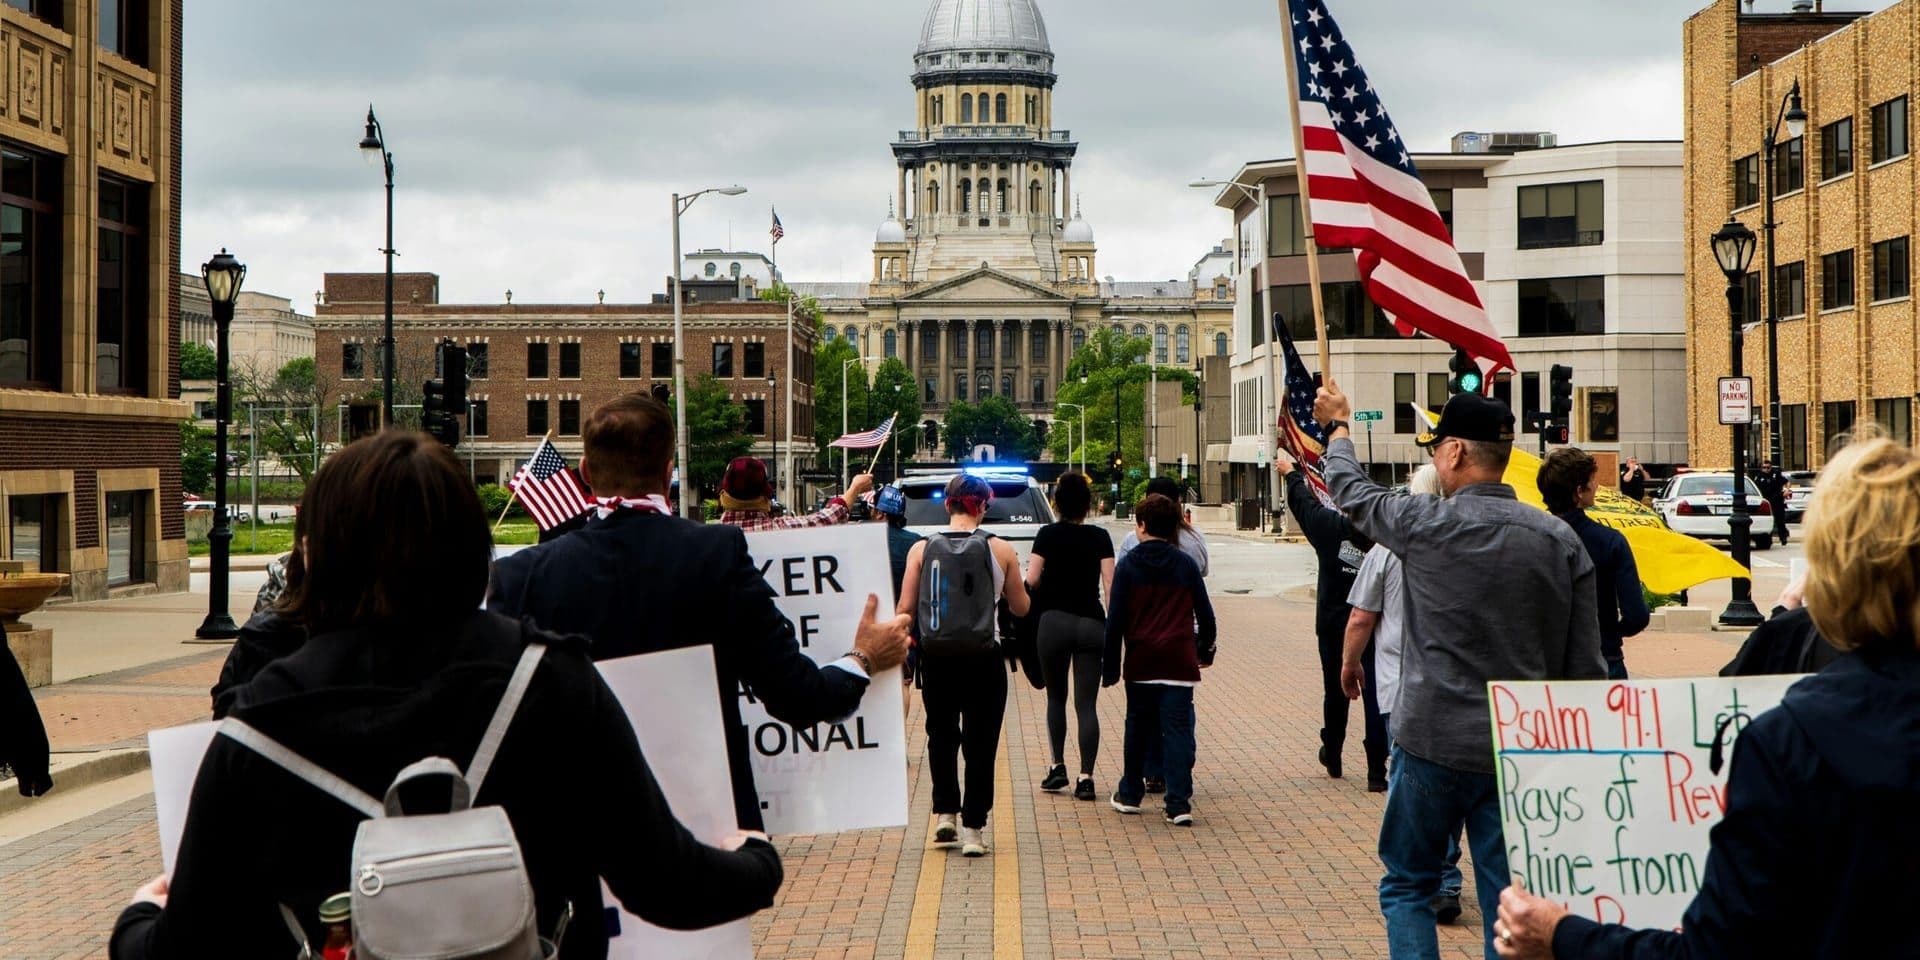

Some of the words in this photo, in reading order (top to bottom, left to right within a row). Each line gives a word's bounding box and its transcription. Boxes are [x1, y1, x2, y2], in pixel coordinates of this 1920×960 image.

[1721, 392, 1748, 401] PARKING
[1729, 382, 1741, 392] NO
[1355, 411, 1368, 421] 5th
[1491, 684, 1593, 752] Psalm
[1606, 684, 1663, 749] 94:1
[1690, 682, 1748, 749] Let
[1500, 756, 1585, 838] Rays
[1604, 753, 1638, 821] of
[1606, 825, 1702, 895] from
